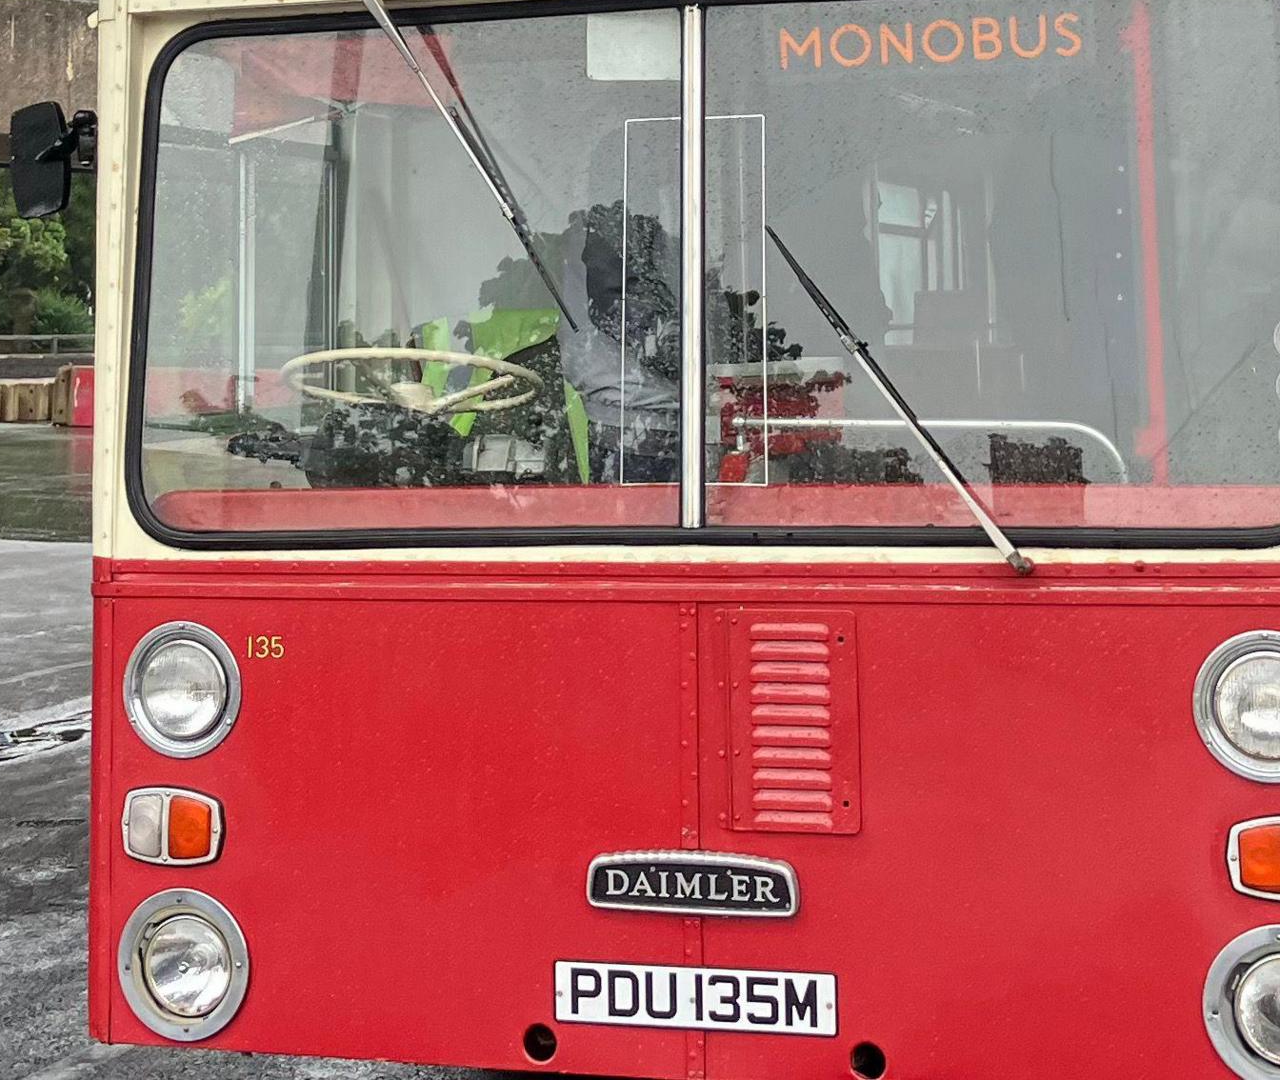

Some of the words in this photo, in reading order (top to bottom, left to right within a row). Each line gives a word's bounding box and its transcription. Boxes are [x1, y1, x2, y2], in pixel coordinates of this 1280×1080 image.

[779, 12, 1084, 70] MONOBUS
[246, 635, 286, 659] 135
[605, 869, 781, 904] DAIMLER
[570, 967, 677, 1020] PDU
[694, 973, 819, 1028] 135M
